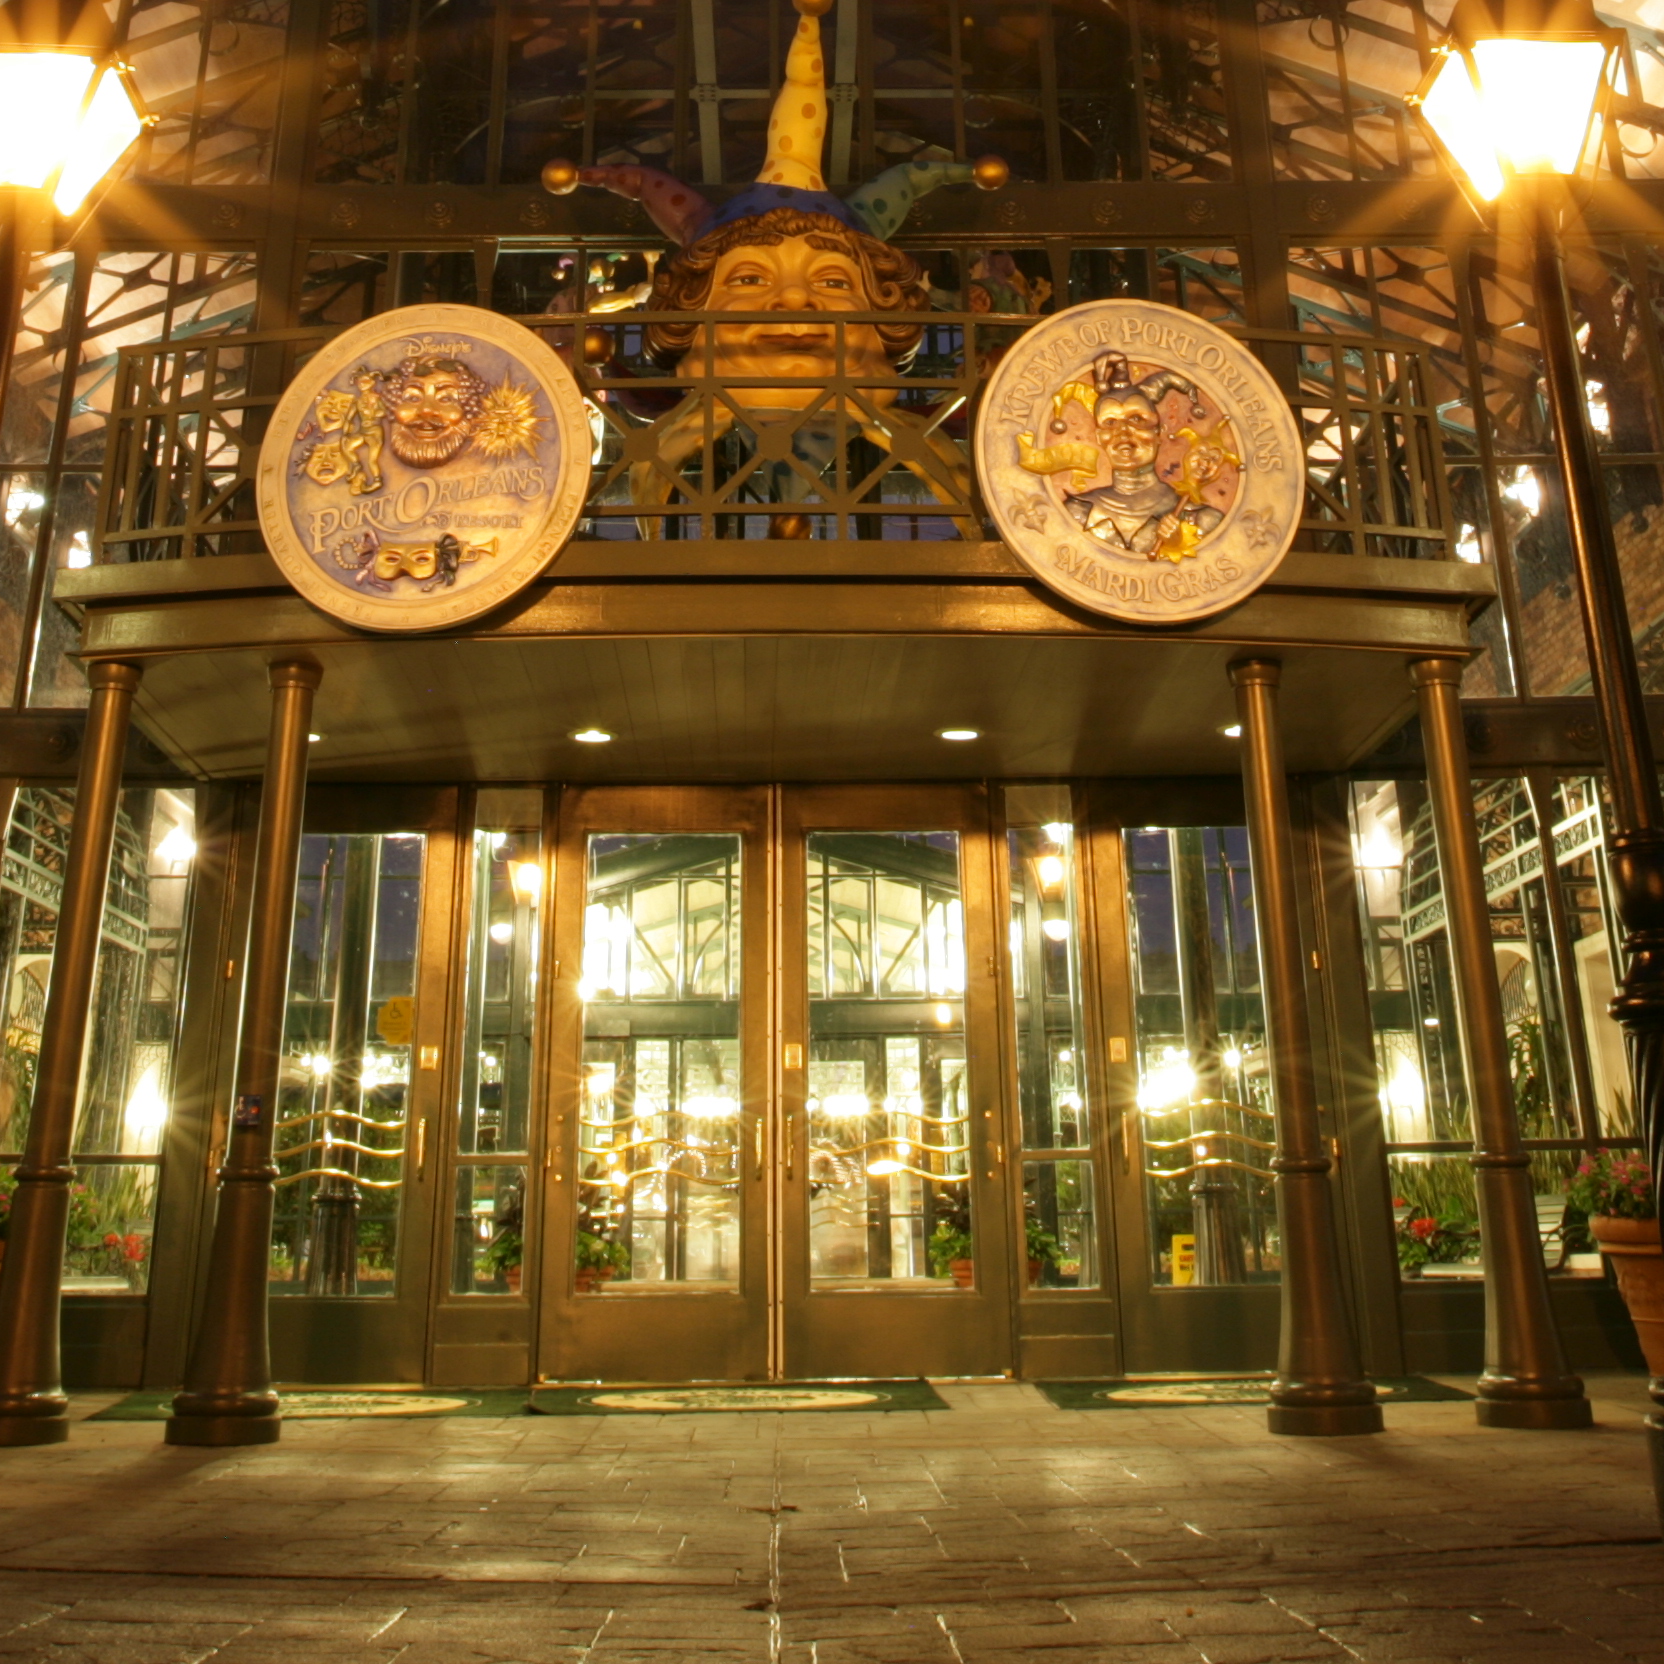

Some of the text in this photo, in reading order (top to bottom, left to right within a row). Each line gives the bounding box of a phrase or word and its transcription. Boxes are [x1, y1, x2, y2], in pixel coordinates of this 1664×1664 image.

[1002, 317, 1283, 473] KREWE OF PORT ORLEANS
[263, 499, 303, 576] QUARTER
[310, 466, 545, 554] PORT ORLEANS
[456, 514, 523, 529] RESORT
[1057, 545, 1241, 602] MARDI GRAS
